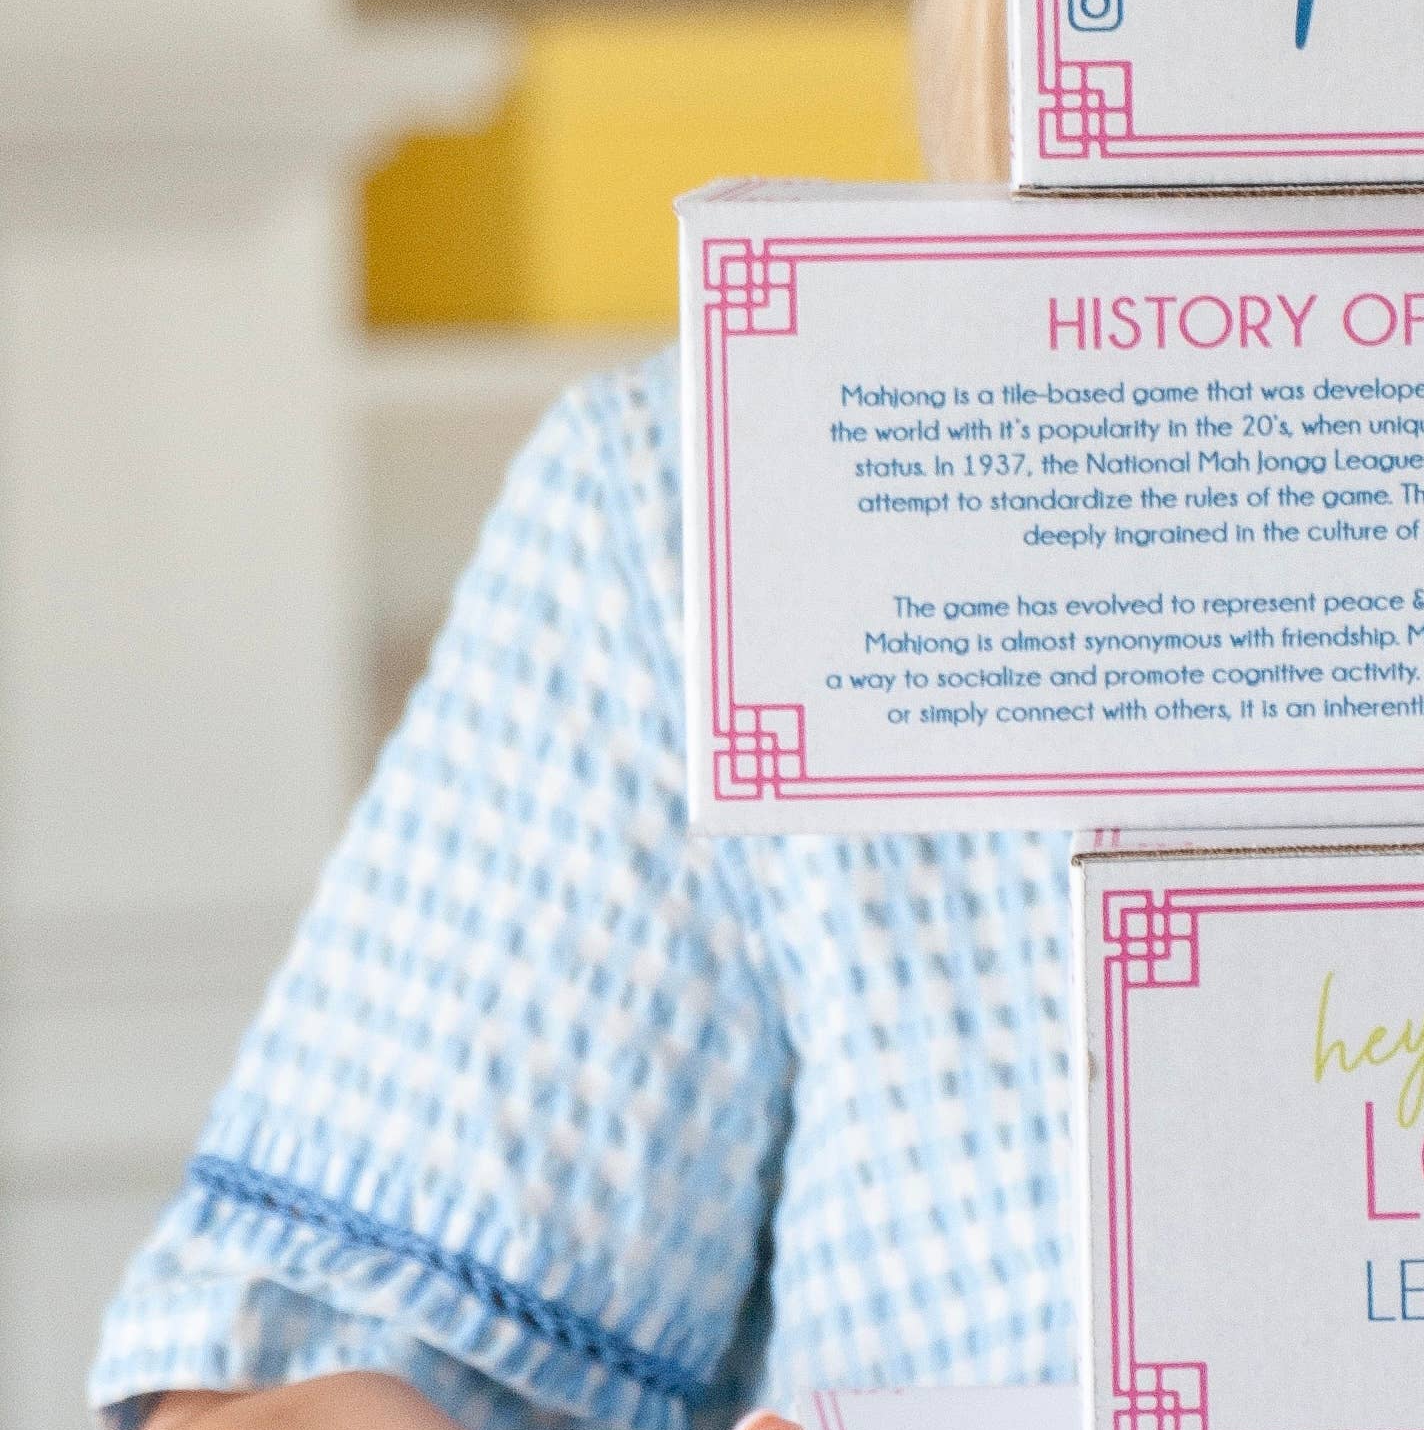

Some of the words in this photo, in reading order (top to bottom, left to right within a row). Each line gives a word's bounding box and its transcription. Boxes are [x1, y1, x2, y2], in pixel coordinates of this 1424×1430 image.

[1046, 292, 1317, 351] HISTORY
[839, 381, 948, 409] Mahjong
[952, 386, 971, 404] is
[976, 387, 996, 404] a
[1000, 380, 1126, 405] tile-based
[1130, 384, 1200, 407] game
[1205, 378, 1254, 401] that
[1258, 382, 1306, 401] was
[829, 419, 868, 442] the
[873, 418, 942, 441] world
[946, 418, 993, 441] with
[997, 419, 1032, 439] it's
[1035, 415, 1160, 442] popularity
[1165, 418, 1188, 438] in
[1193, 414, 1234, 437] the
[1243, 411, 1293, 437] 20's,
[1300, 412, 1363, 435] when
[854, 456, 925, 476] status.
[932, 455, 956, 475] In
[964, 451, 1033, 479] 1937,
[1039, 451, 1079, 474] the
[1084, 450, 1192, 475] National
[1196, 449, 1252, 472] Mah
[1255, 450, 1329, 475] Jongg
[1331, 449, 1424, 475] League
[856, 491, 951, 513] attempt
[955, 489, 983, 510] to
[989, 486, 1132, 510] standardize
[1139, 486, 1178, 507] the
[1183, 485, 1239, 508] rules
[1245, 485, 1271, 507] of
[1275, 483, 1315, 506] the
[1320, 487, 1390, 510] game.
[1022, 523, 1107, 548] deeply
[1112, 520, 1230, 547] ingrained
[1233, 524, 1256, 541] in
[1261, 520, 1301, 541] the
[1306, 518, 1390, 541] culture
[1396, 518, 1420, 538] of
[894, 593, 936, 618] The
[941, 599, 1010, 620] game
[1015, 594, 1058, 617] has
[1064, 591, 1164, 615] evolved
[1169, 593, 1197, 614] to
[1202, 591, 1317, 616] represent
[1321, 593, 1405, 616] peace
[863, 630, 972, 656] Mahjong
[975, 633, 994, 652] is
[1000, 629, 1077, 651] almost
[1083, 631, 1224, 652] synonymous
[1227, 625, 1276, 648] with
[1279, 623, 1398, 649] friendship.
[825, 671, 843, 688] a
[847, 672, 897, 690] way
[902, 668, 931, 685] to
[936, 665, 1041, 689] socialize
[1048, 664, 1099, 685] and
[1102, 664, 1205, 687] promote
[1209, 663, 1325, 688] cognitive
[1330, 660, 1418, 682] activity.
[887, 706, 911, 722] or
[918, 700, 988, 726] simply
[995, 700, 1095, 721] connect
[1101, 698, 1149, 721] with
[1152, 696, 1233, 720] others,
[1239, 697, 1255, 715] it
[1260, 700, 1279, 717] is
[1284, 700, 1317, 718] an
